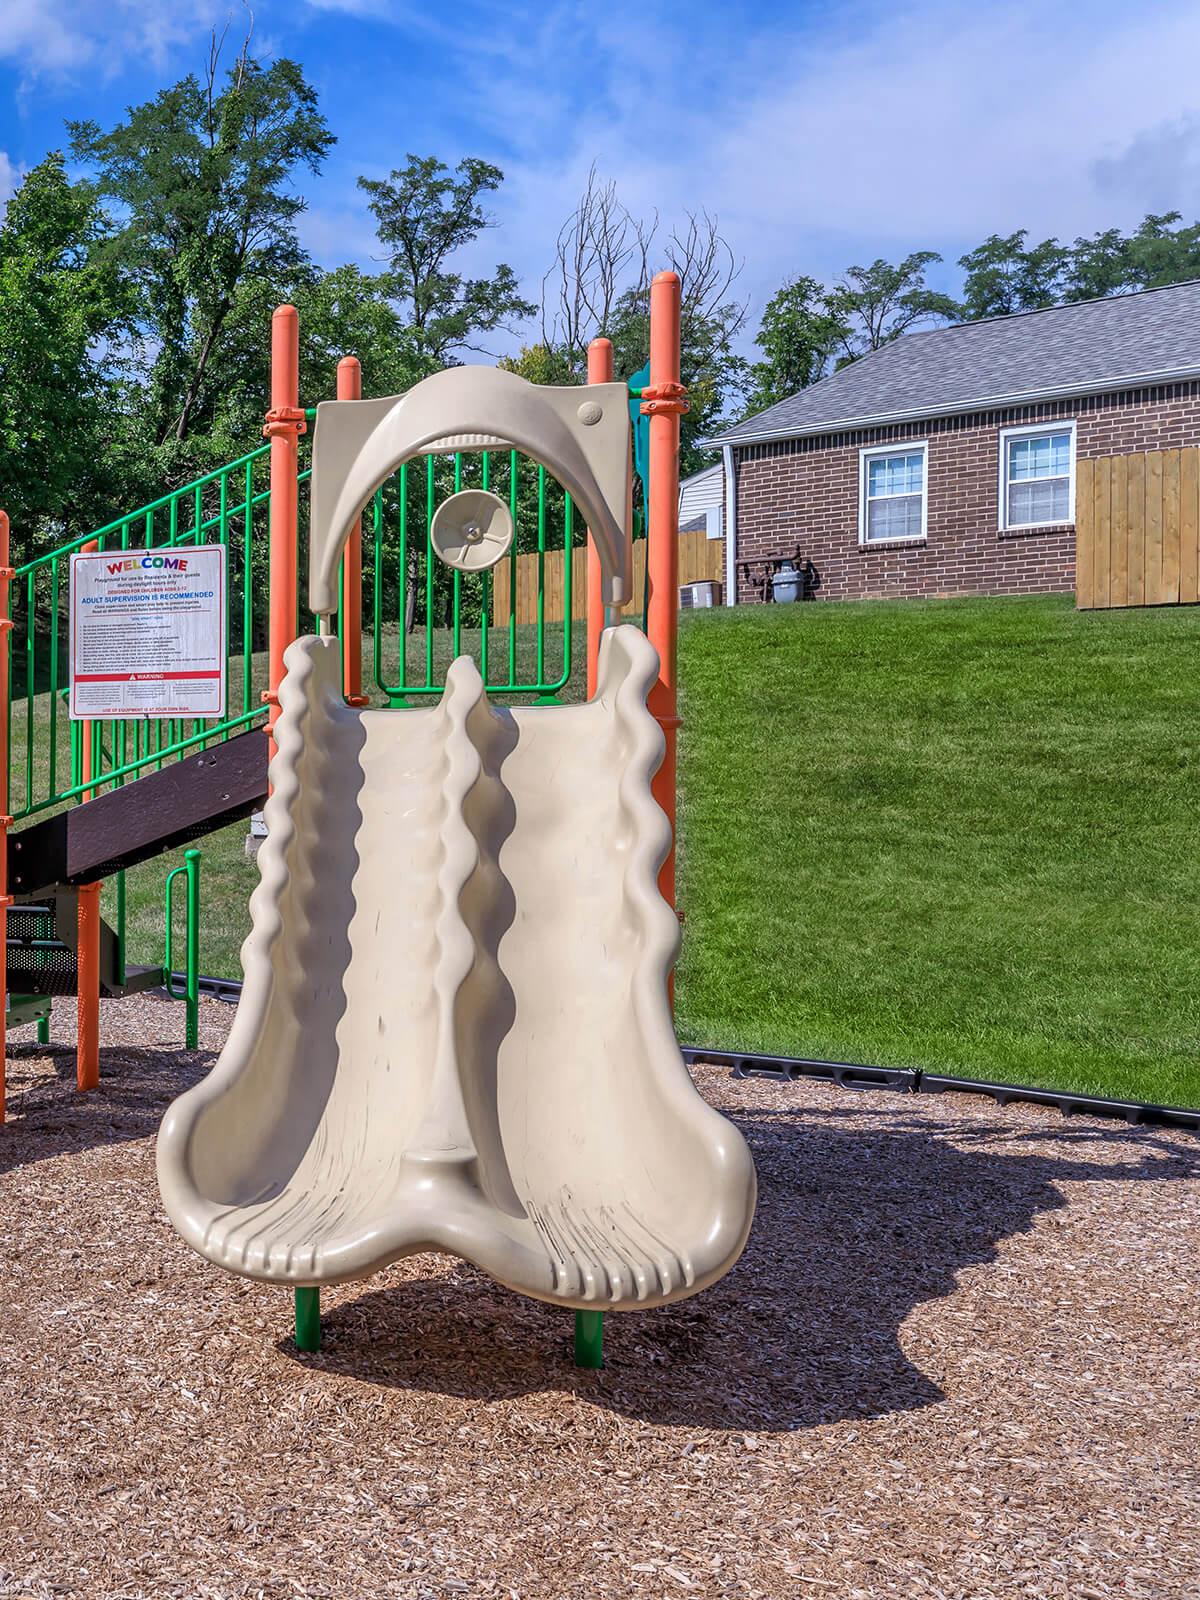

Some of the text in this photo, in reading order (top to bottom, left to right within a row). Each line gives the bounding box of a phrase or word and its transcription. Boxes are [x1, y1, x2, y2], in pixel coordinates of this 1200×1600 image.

[106, 557, 188, 575] WELCOME
[104, 595, 150, 603] SUPERVISION
[160, 592, 214, 600] RECOMMENDED
